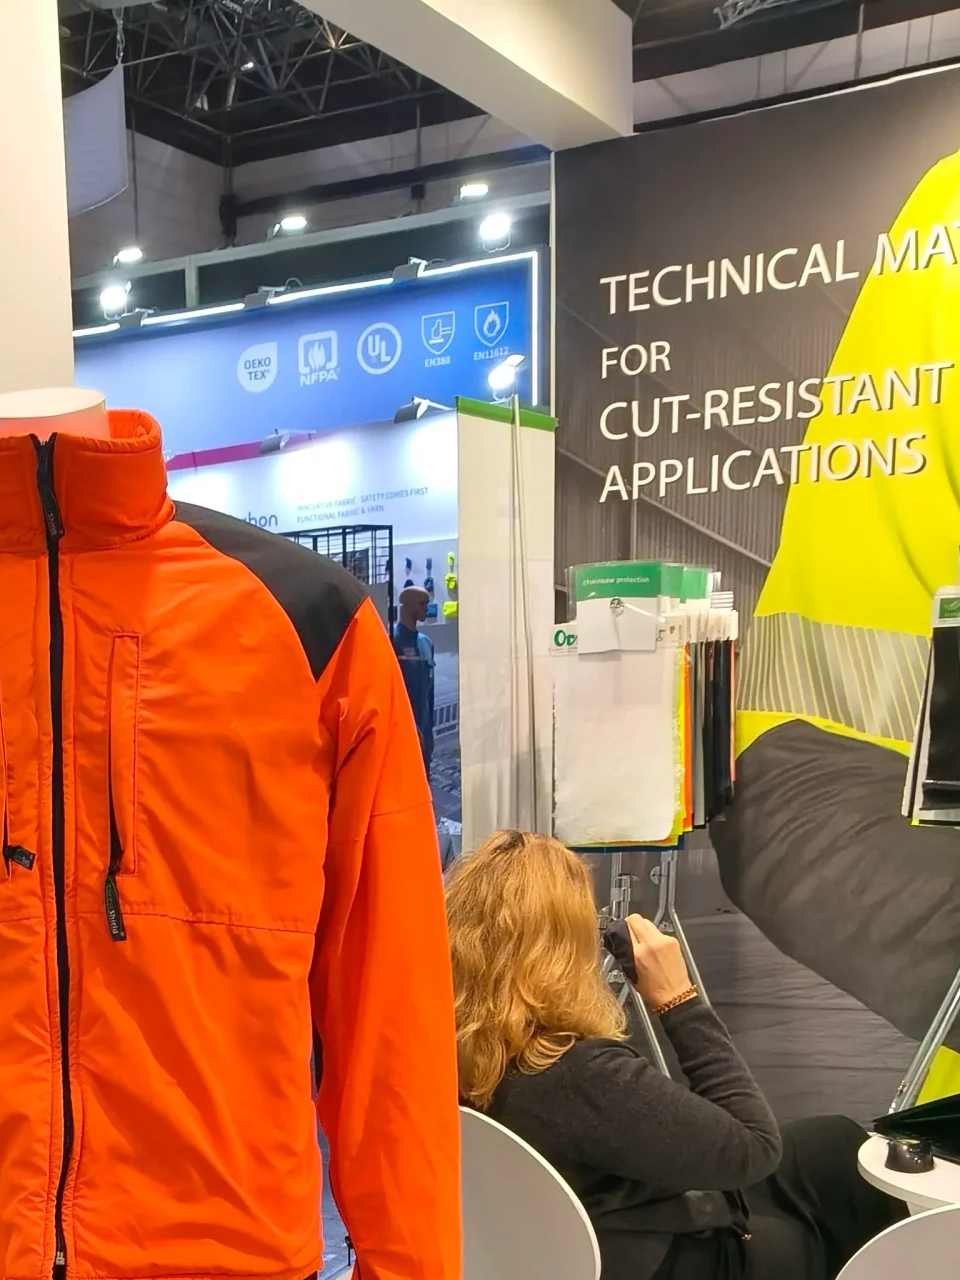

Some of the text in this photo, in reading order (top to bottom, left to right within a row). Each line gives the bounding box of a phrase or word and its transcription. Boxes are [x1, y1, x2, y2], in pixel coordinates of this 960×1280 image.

[599, 222, 960, 315] TECHNICAL MA
[367, 334, 392, 363] UL
[600, 340, 671, 379] FOR
[244, 356, 271, 370] OEKO
[598, 362, 954, 441] CUT-RESISTANT
[598, 433, 927, 503] APPLICATIONS
[385, 488, 410, 500] COMES
[409, 486, 429, 497] FIRST
[243, 511, 278, 527] bon
[296, 512, 336, 524] FUNCTIONAL
[367, 504, 385, 514] YARN
[582, 576, 650, 586] chainsaw protection
